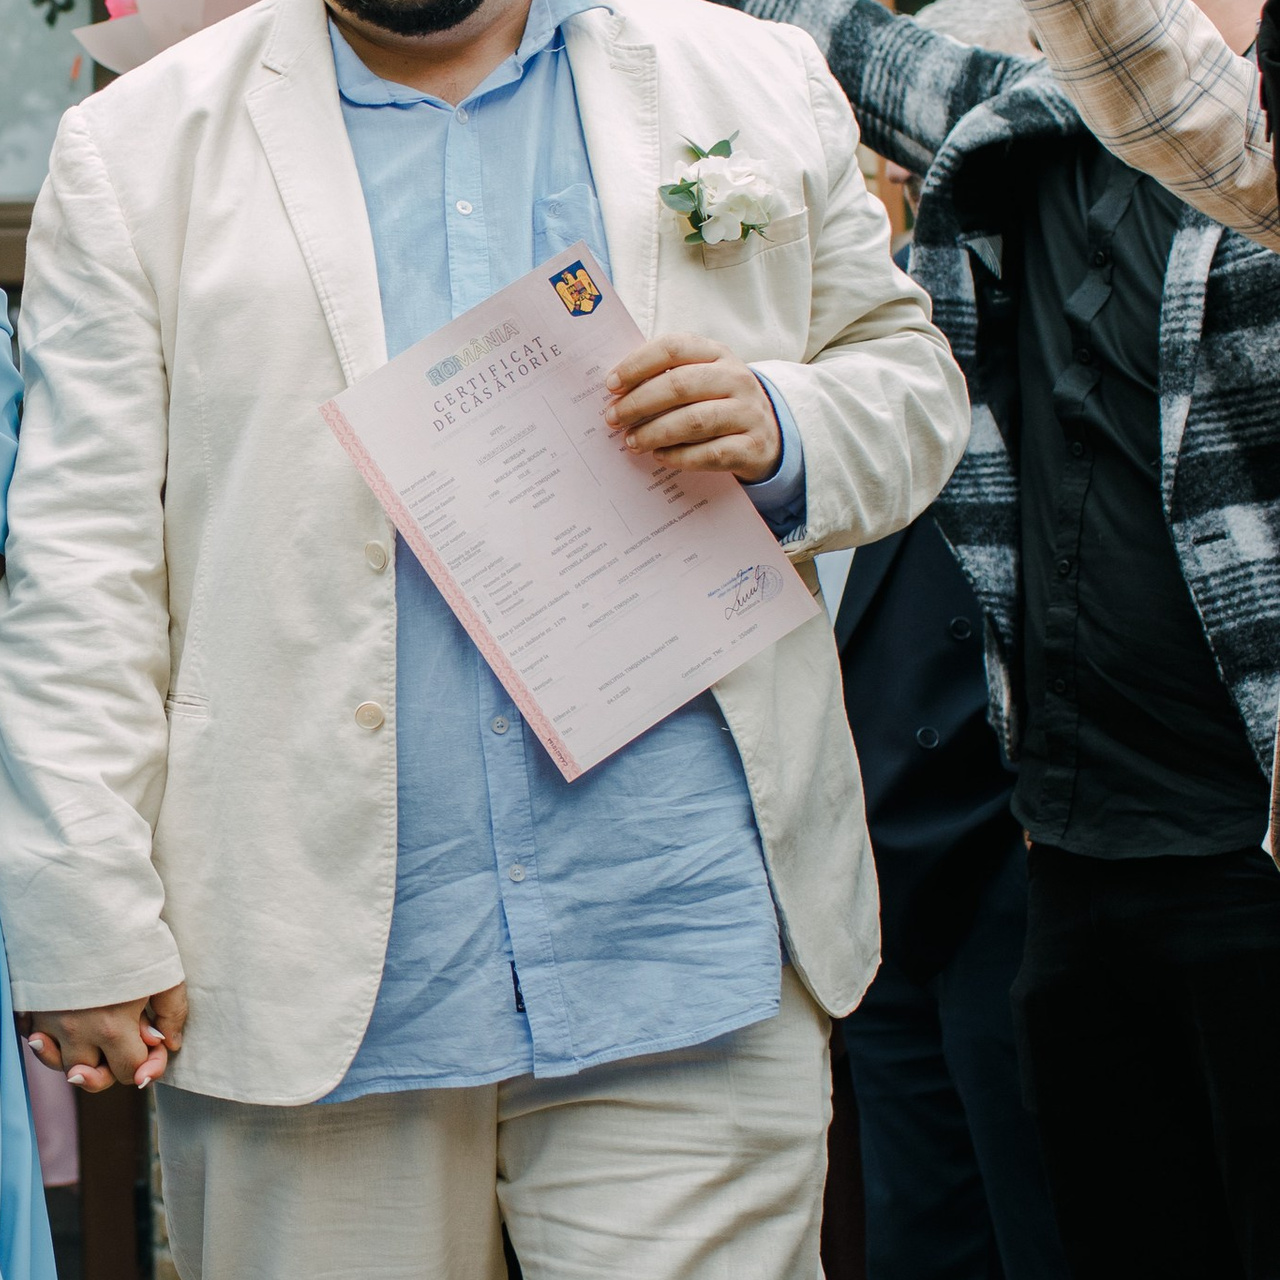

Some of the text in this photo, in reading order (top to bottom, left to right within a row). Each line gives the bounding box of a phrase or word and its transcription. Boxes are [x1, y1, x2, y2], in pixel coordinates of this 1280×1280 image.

[423, 315, 520, 387] ROMÂNIA
[431, 335, 545, 413] CERTIFICAT
[432, 411, 456, 432] DE
[457, 341, 562, 415] CĂSĂTORIE
